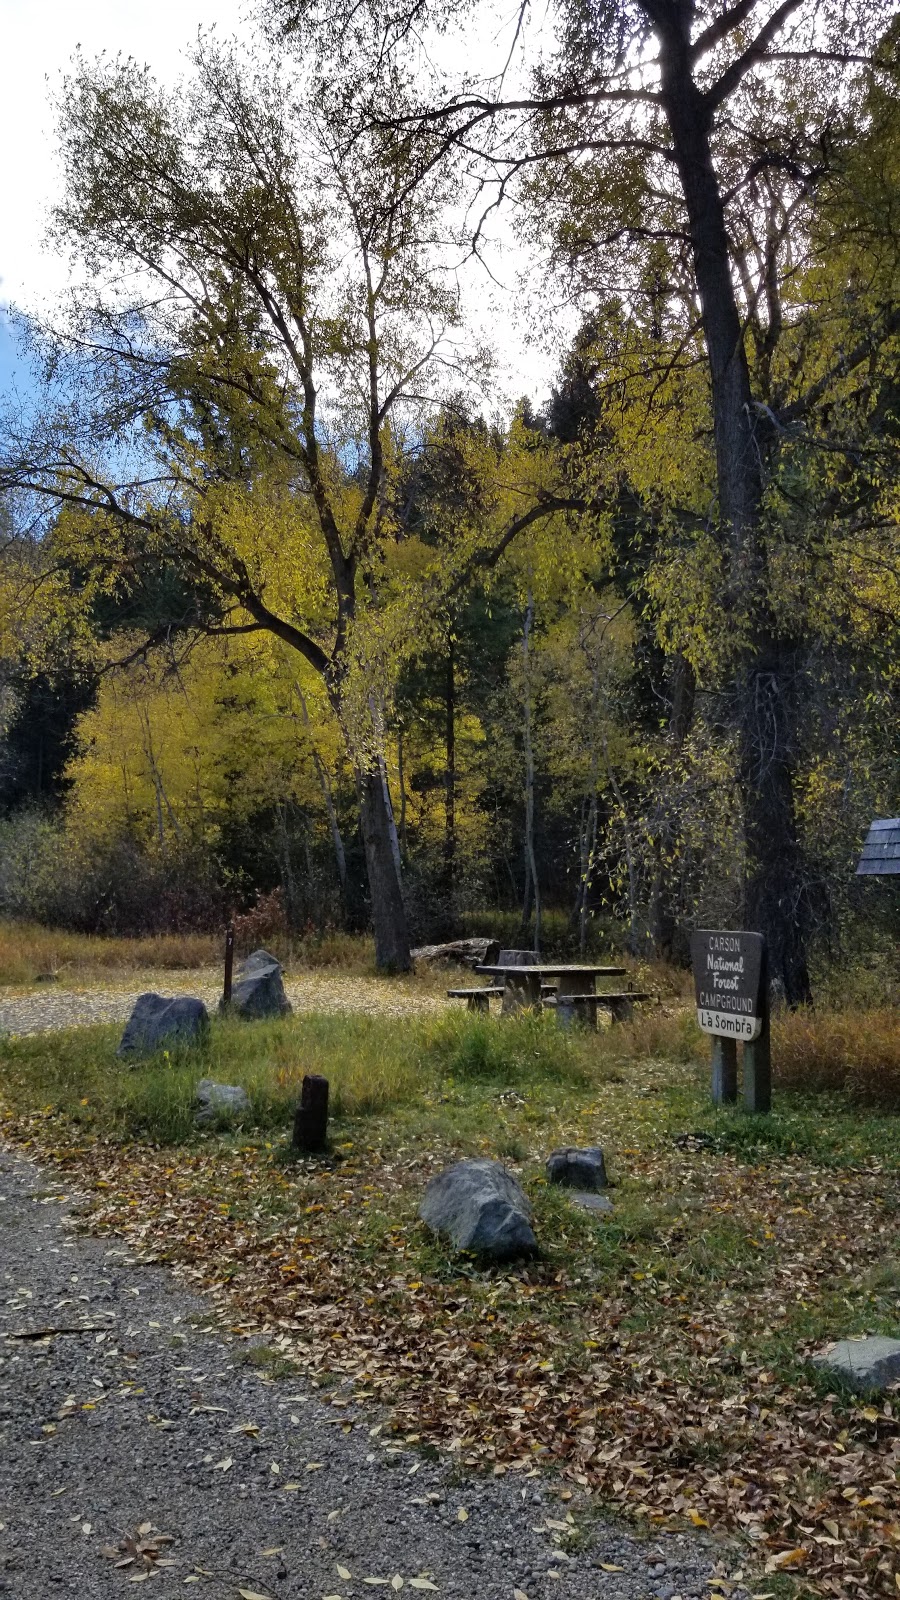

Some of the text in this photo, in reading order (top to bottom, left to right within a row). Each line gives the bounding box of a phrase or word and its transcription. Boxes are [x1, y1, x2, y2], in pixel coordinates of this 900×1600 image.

[228, 937, 233, 946] 7
[709, 936, 740, 952] CARSON
[707, 953, 744, 973] National
[713, 972, 739, 990] Forest
[699, 991, 752, 1013] CAMPGROUND
[701, 1012, 752, 1034] La Sombra
